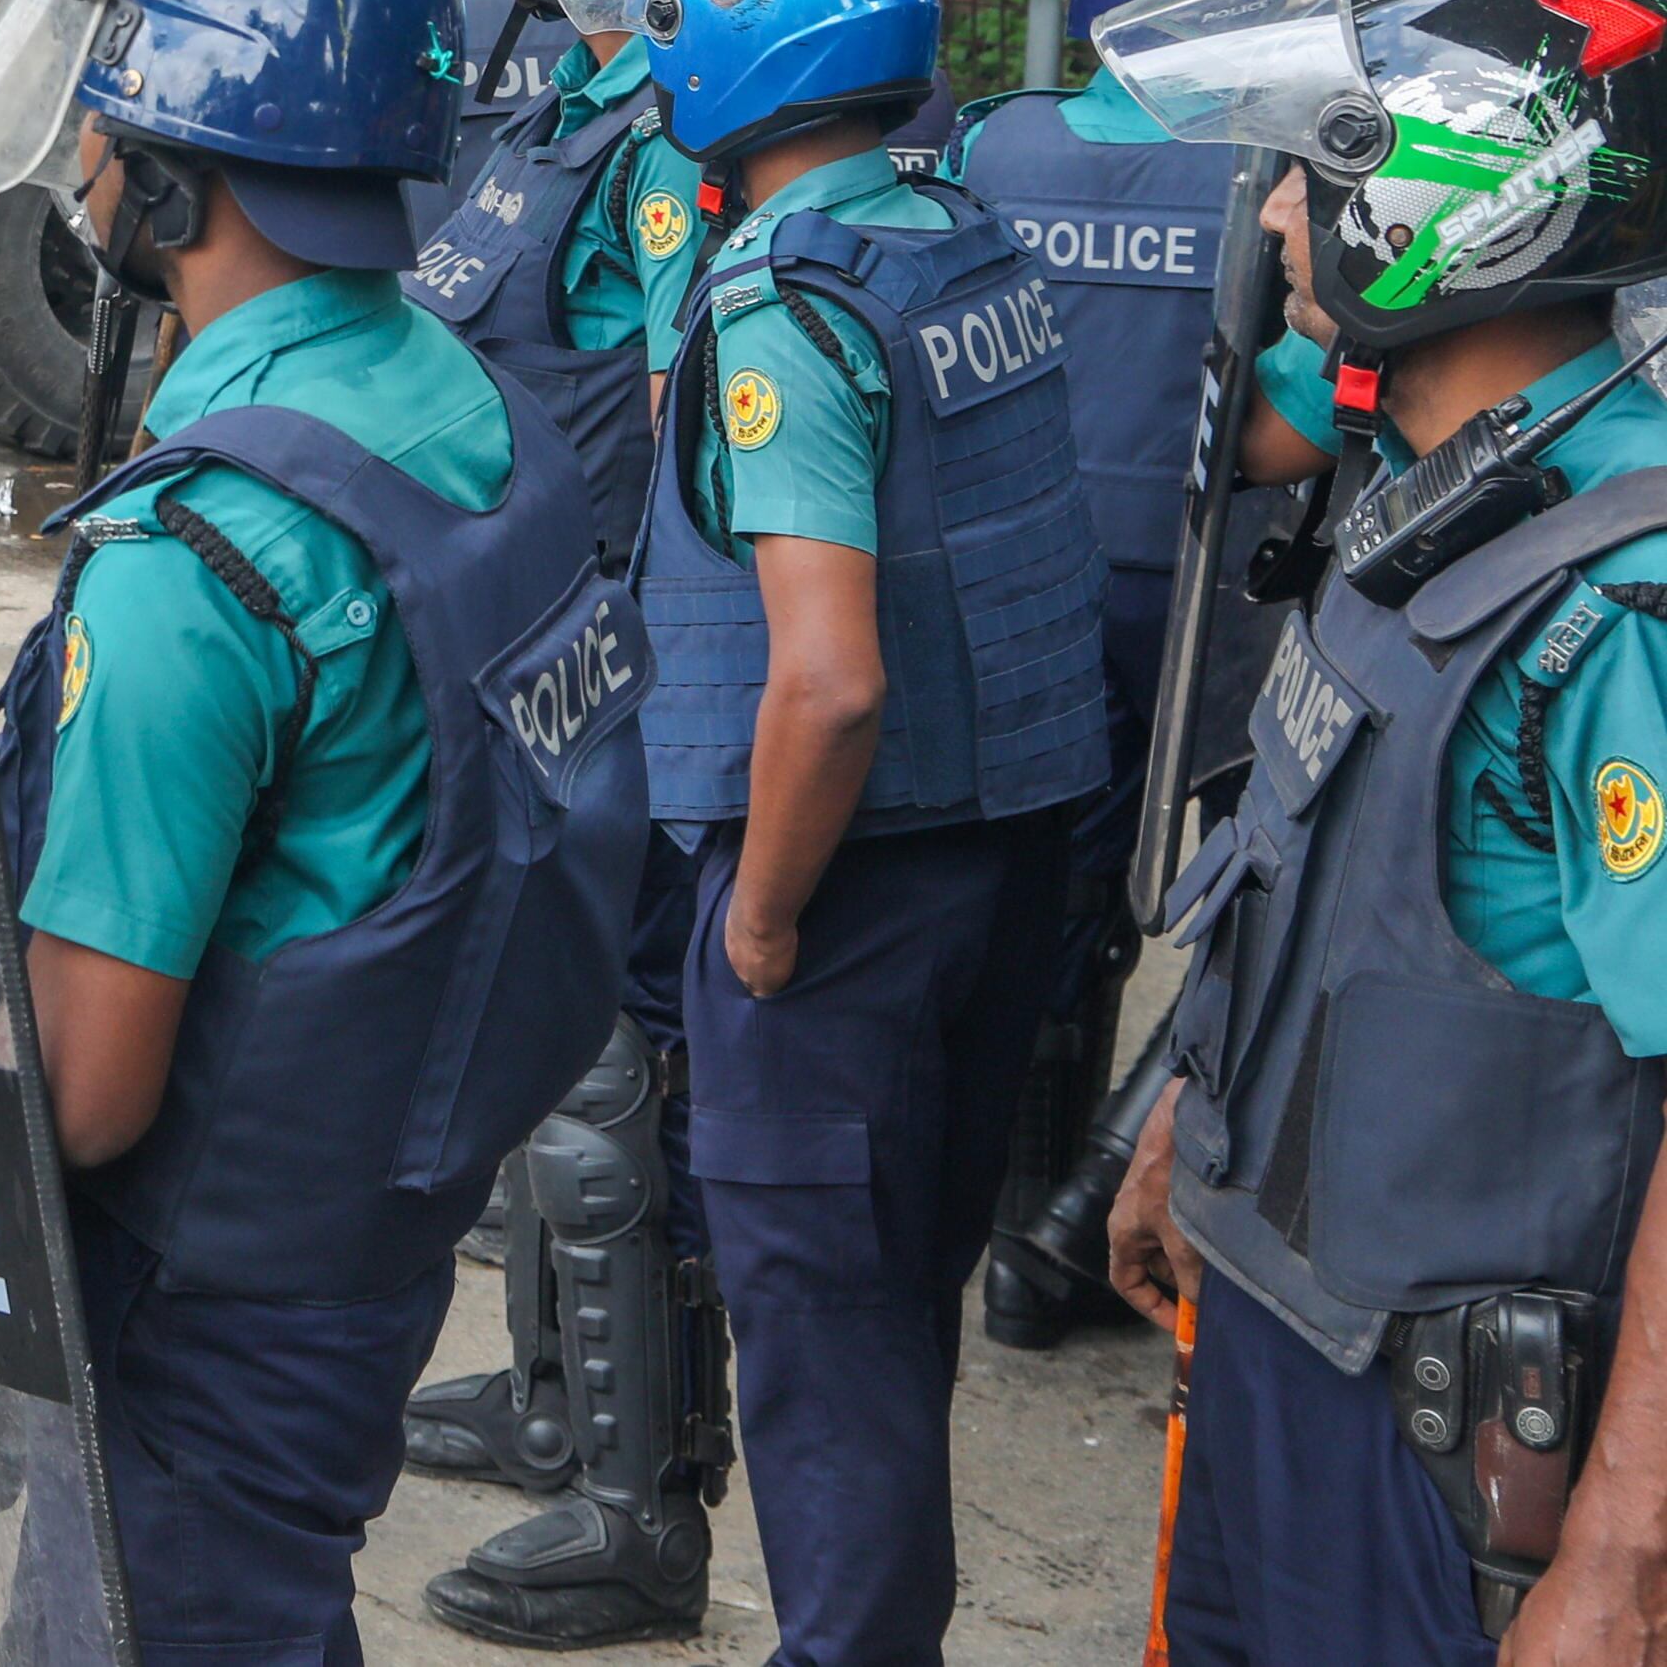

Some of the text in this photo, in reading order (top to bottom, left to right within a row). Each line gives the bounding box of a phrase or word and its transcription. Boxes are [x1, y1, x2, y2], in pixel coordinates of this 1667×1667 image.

[1438, 119, 1607, 246] SPLITTER
[1014, 219, 1197, 274] POLICE
[919, 278, 1064, 399] POLICE
[509, 600, 633, 777] POLICE
[1264, 624, 1354, 782] POLICE
